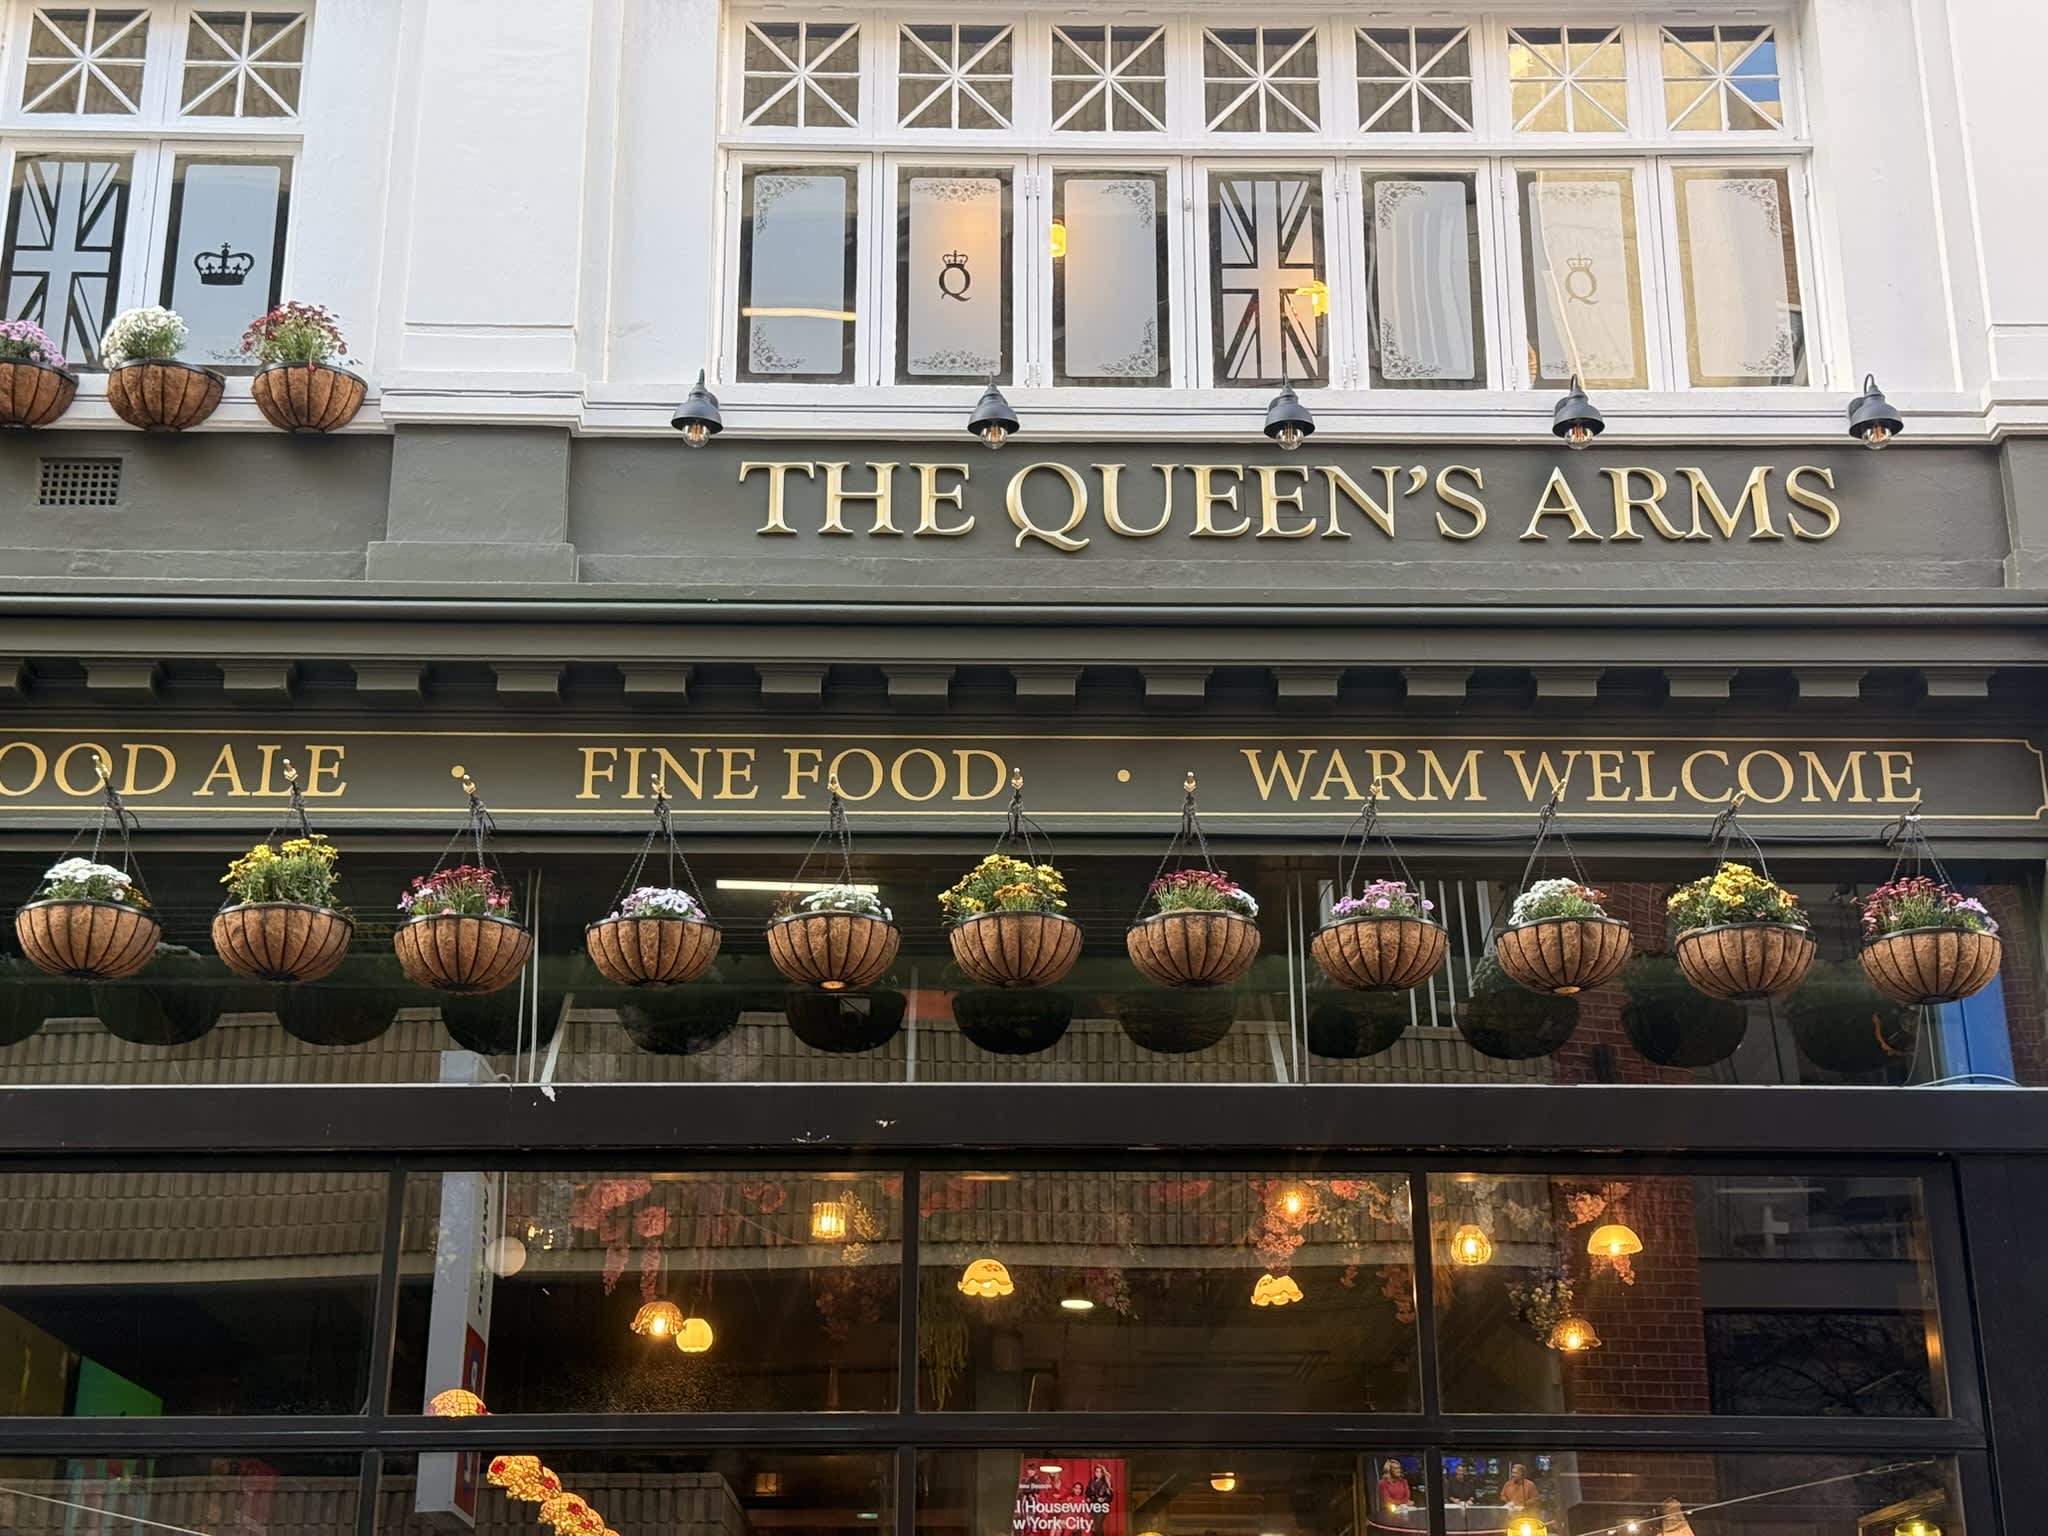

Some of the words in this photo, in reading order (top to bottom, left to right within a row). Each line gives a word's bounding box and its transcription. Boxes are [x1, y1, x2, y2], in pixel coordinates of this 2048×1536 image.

[939, 265, 972, 302] Q
[1565, 270, 1599, 305] Q
[738, 461, 976, 536] THE
[1005, 462, 1488, 552] QUEEN'S
[1518, 465, 1842, 542] ARMS
[192, 744, 348, 797] ALE
[575, 747, 760, 800] FINE
[781, 748, 1008, 801] FOOD
[1240, 749, 1488, 801] WARM
[1504, 750, 1923, 803] WELCOME
[1025, 1500, 1110, 1514] Housewives
[1030, 1516, 1062, 1530] York
[1065, 1516, 1094, 1534] City
